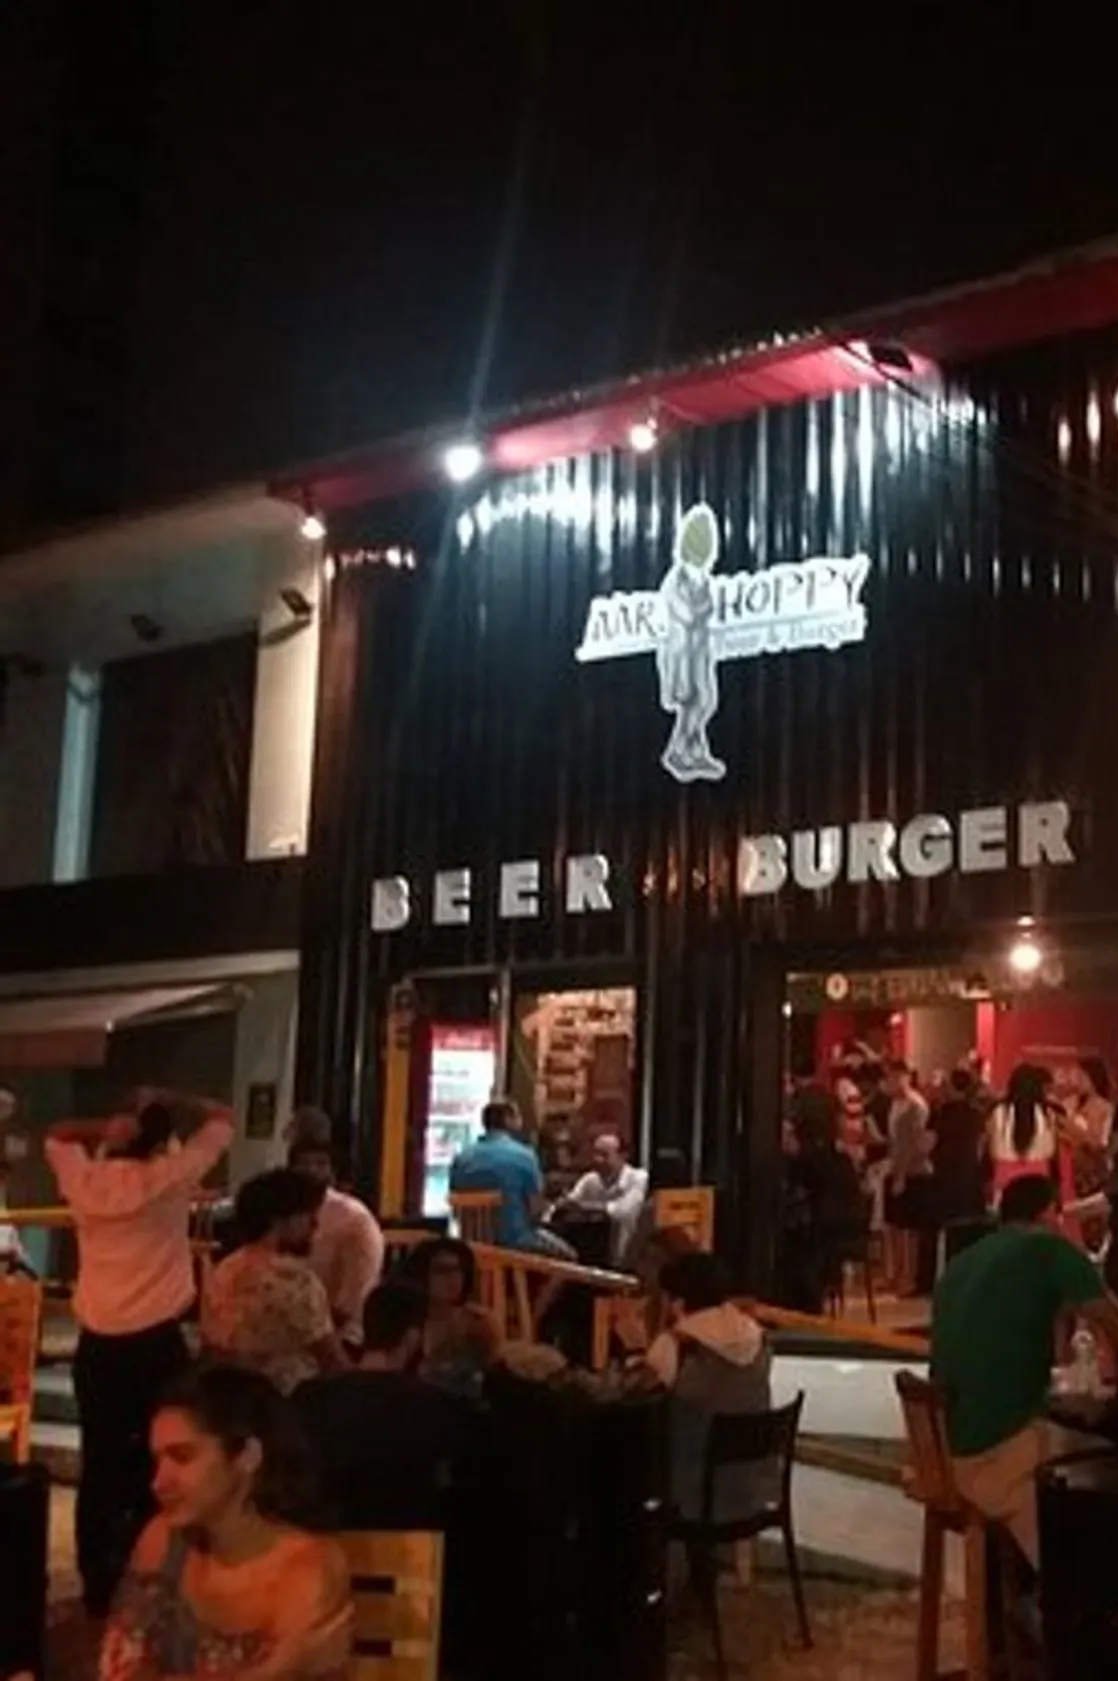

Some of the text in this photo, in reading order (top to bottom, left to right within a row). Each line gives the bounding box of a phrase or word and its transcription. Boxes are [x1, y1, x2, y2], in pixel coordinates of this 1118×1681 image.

[717, 560, 863, 624] HOPPY
[371, 801, 1076, 932] BEER BURGER
